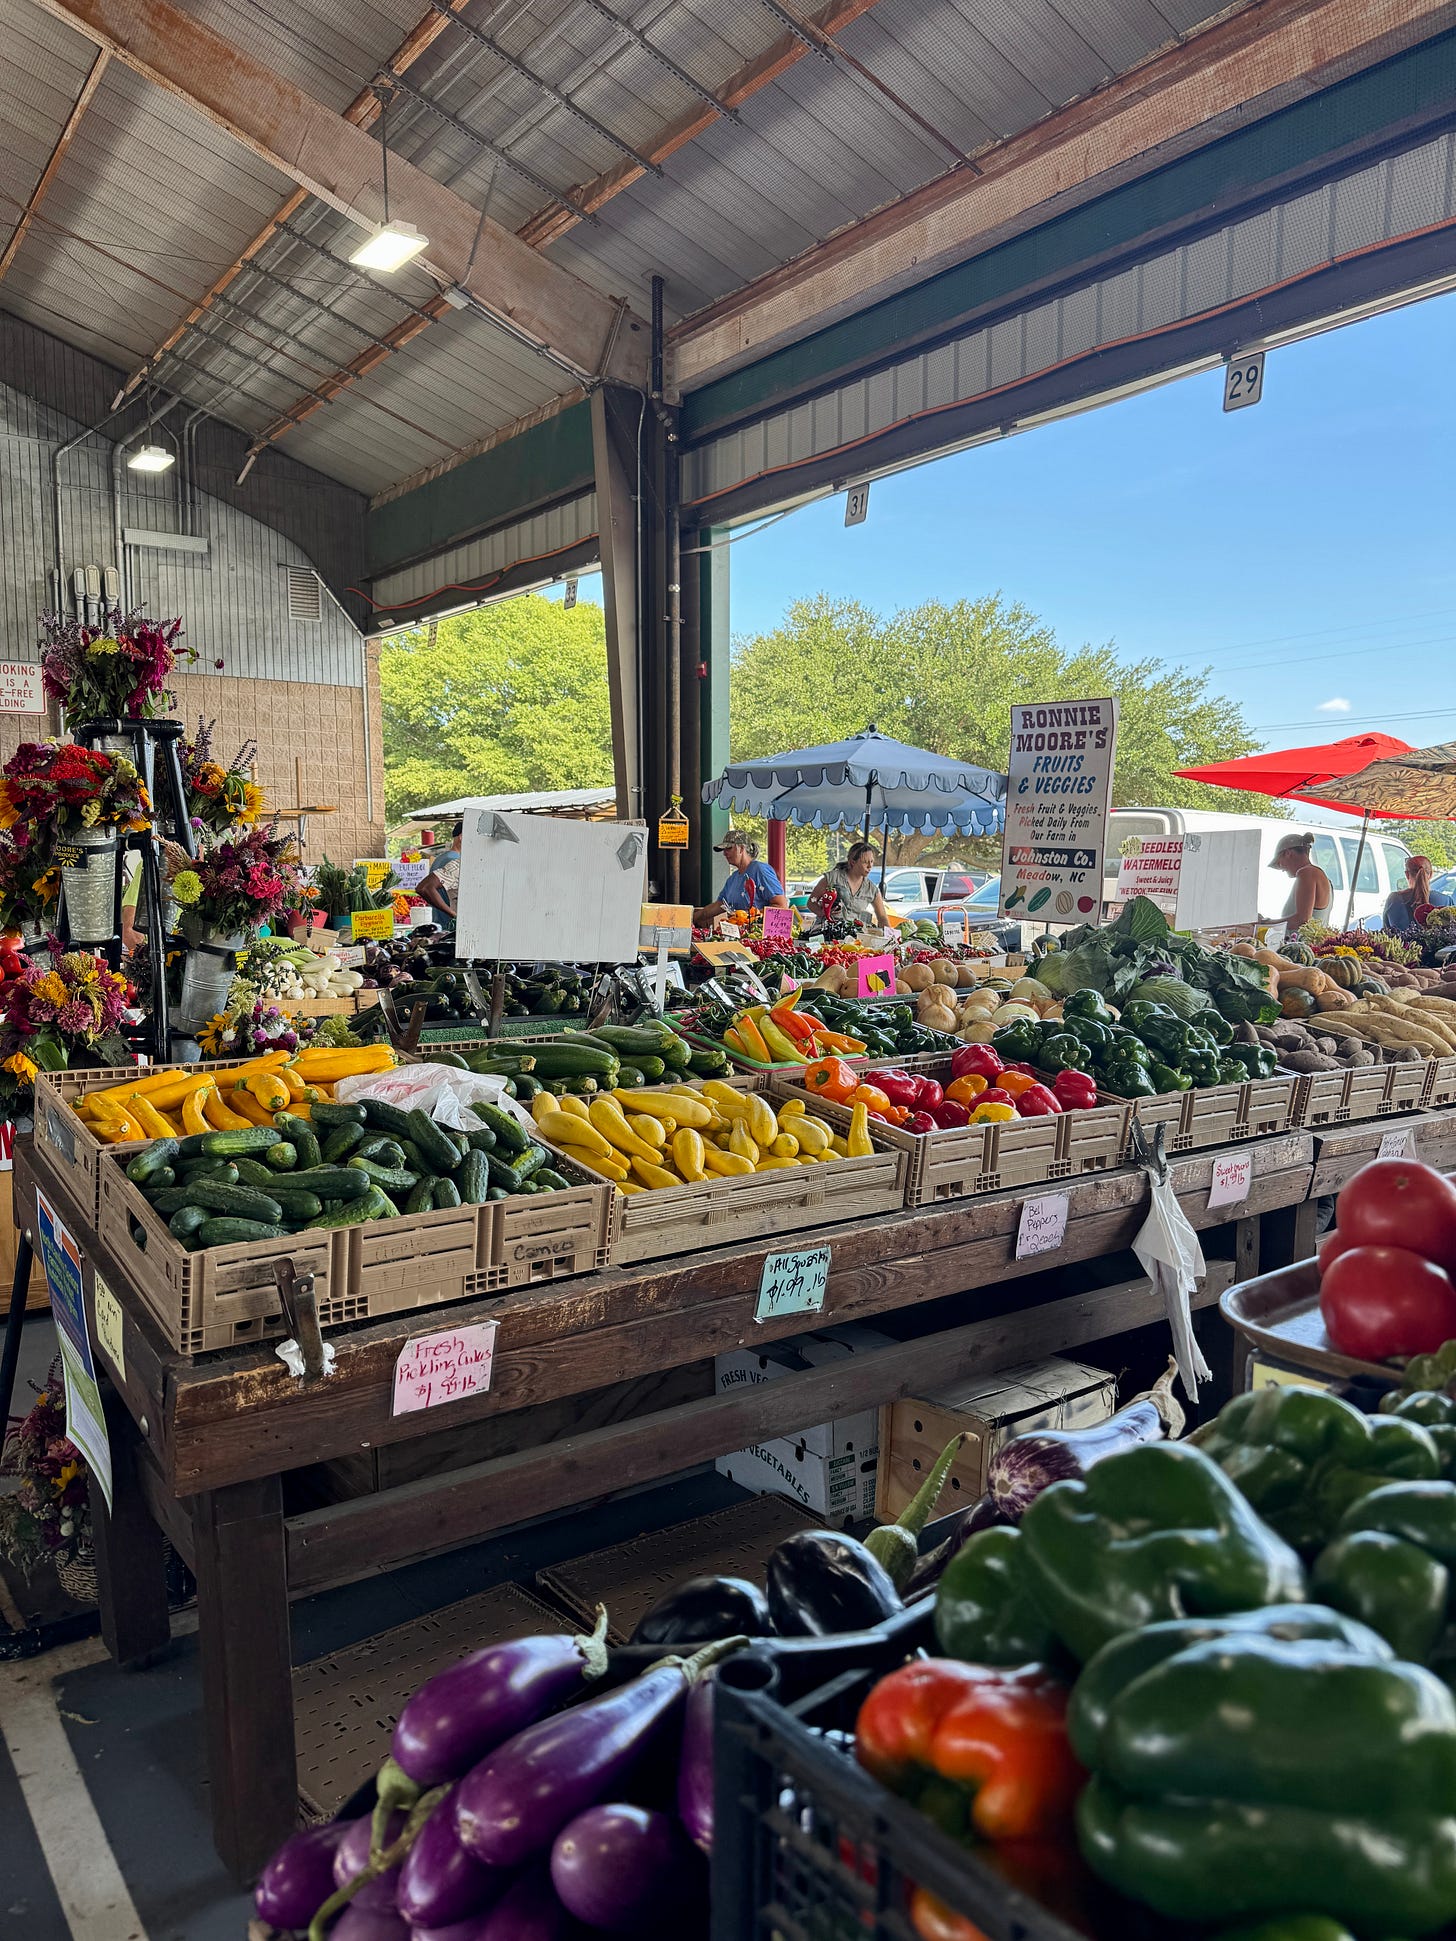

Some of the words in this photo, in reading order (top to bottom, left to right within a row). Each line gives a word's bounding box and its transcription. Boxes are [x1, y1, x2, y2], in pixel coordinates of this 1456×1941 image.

[1229, 365, 1259, 400] 29
[850, 493, 864, 516] 31
[566, 585, 576, 602] 33
[0, 664, 35, 676] OKING
[6, 678, 15, 687] IS
[24, 679, 29, 688] A
[1021, 705, 1102, 729] RONNIE
[1015, 728, 1109, 752] MOORE'S
[1032, 755, 1085, 773] FRUITS
[1018, 777, 1029, 794] &
[1035, 776, 1096, 794] VEGGIES
[1014, 803, 1035, 814] Fresh
[1037, 803, 1056, 814] Fruit
[1058, 804, 1065, 813] &
[1068, 803, 1099, 817] Veggies
[1019, 816, 1043, 827] Picked
[1047, 817, 1067, 830] Daily
[1070, 817, 1090, 828] From
[1030, 830, 1043, 840] Our
[1046, 830, 1065, 841] Farm
[1068, 831, 1077, 841] in
[56, 845, 84, 854] OORE'S
[1140, 842, 1183, 853] SEEDLESS
[1011, 848, 1069, 865] Johnston
[1073, 850, 1093, 867] Co.
[1016, 868, 1063, 883] Meadow,
[1069, 872, 1086, 883] NC
[773, 1257, 789, 1274] All
[416, 1336, 465, 1359] Fresh
[720, 1369, 747, 1389] FRESH
[748, 1443, 810, 1504] VEGETABLES
